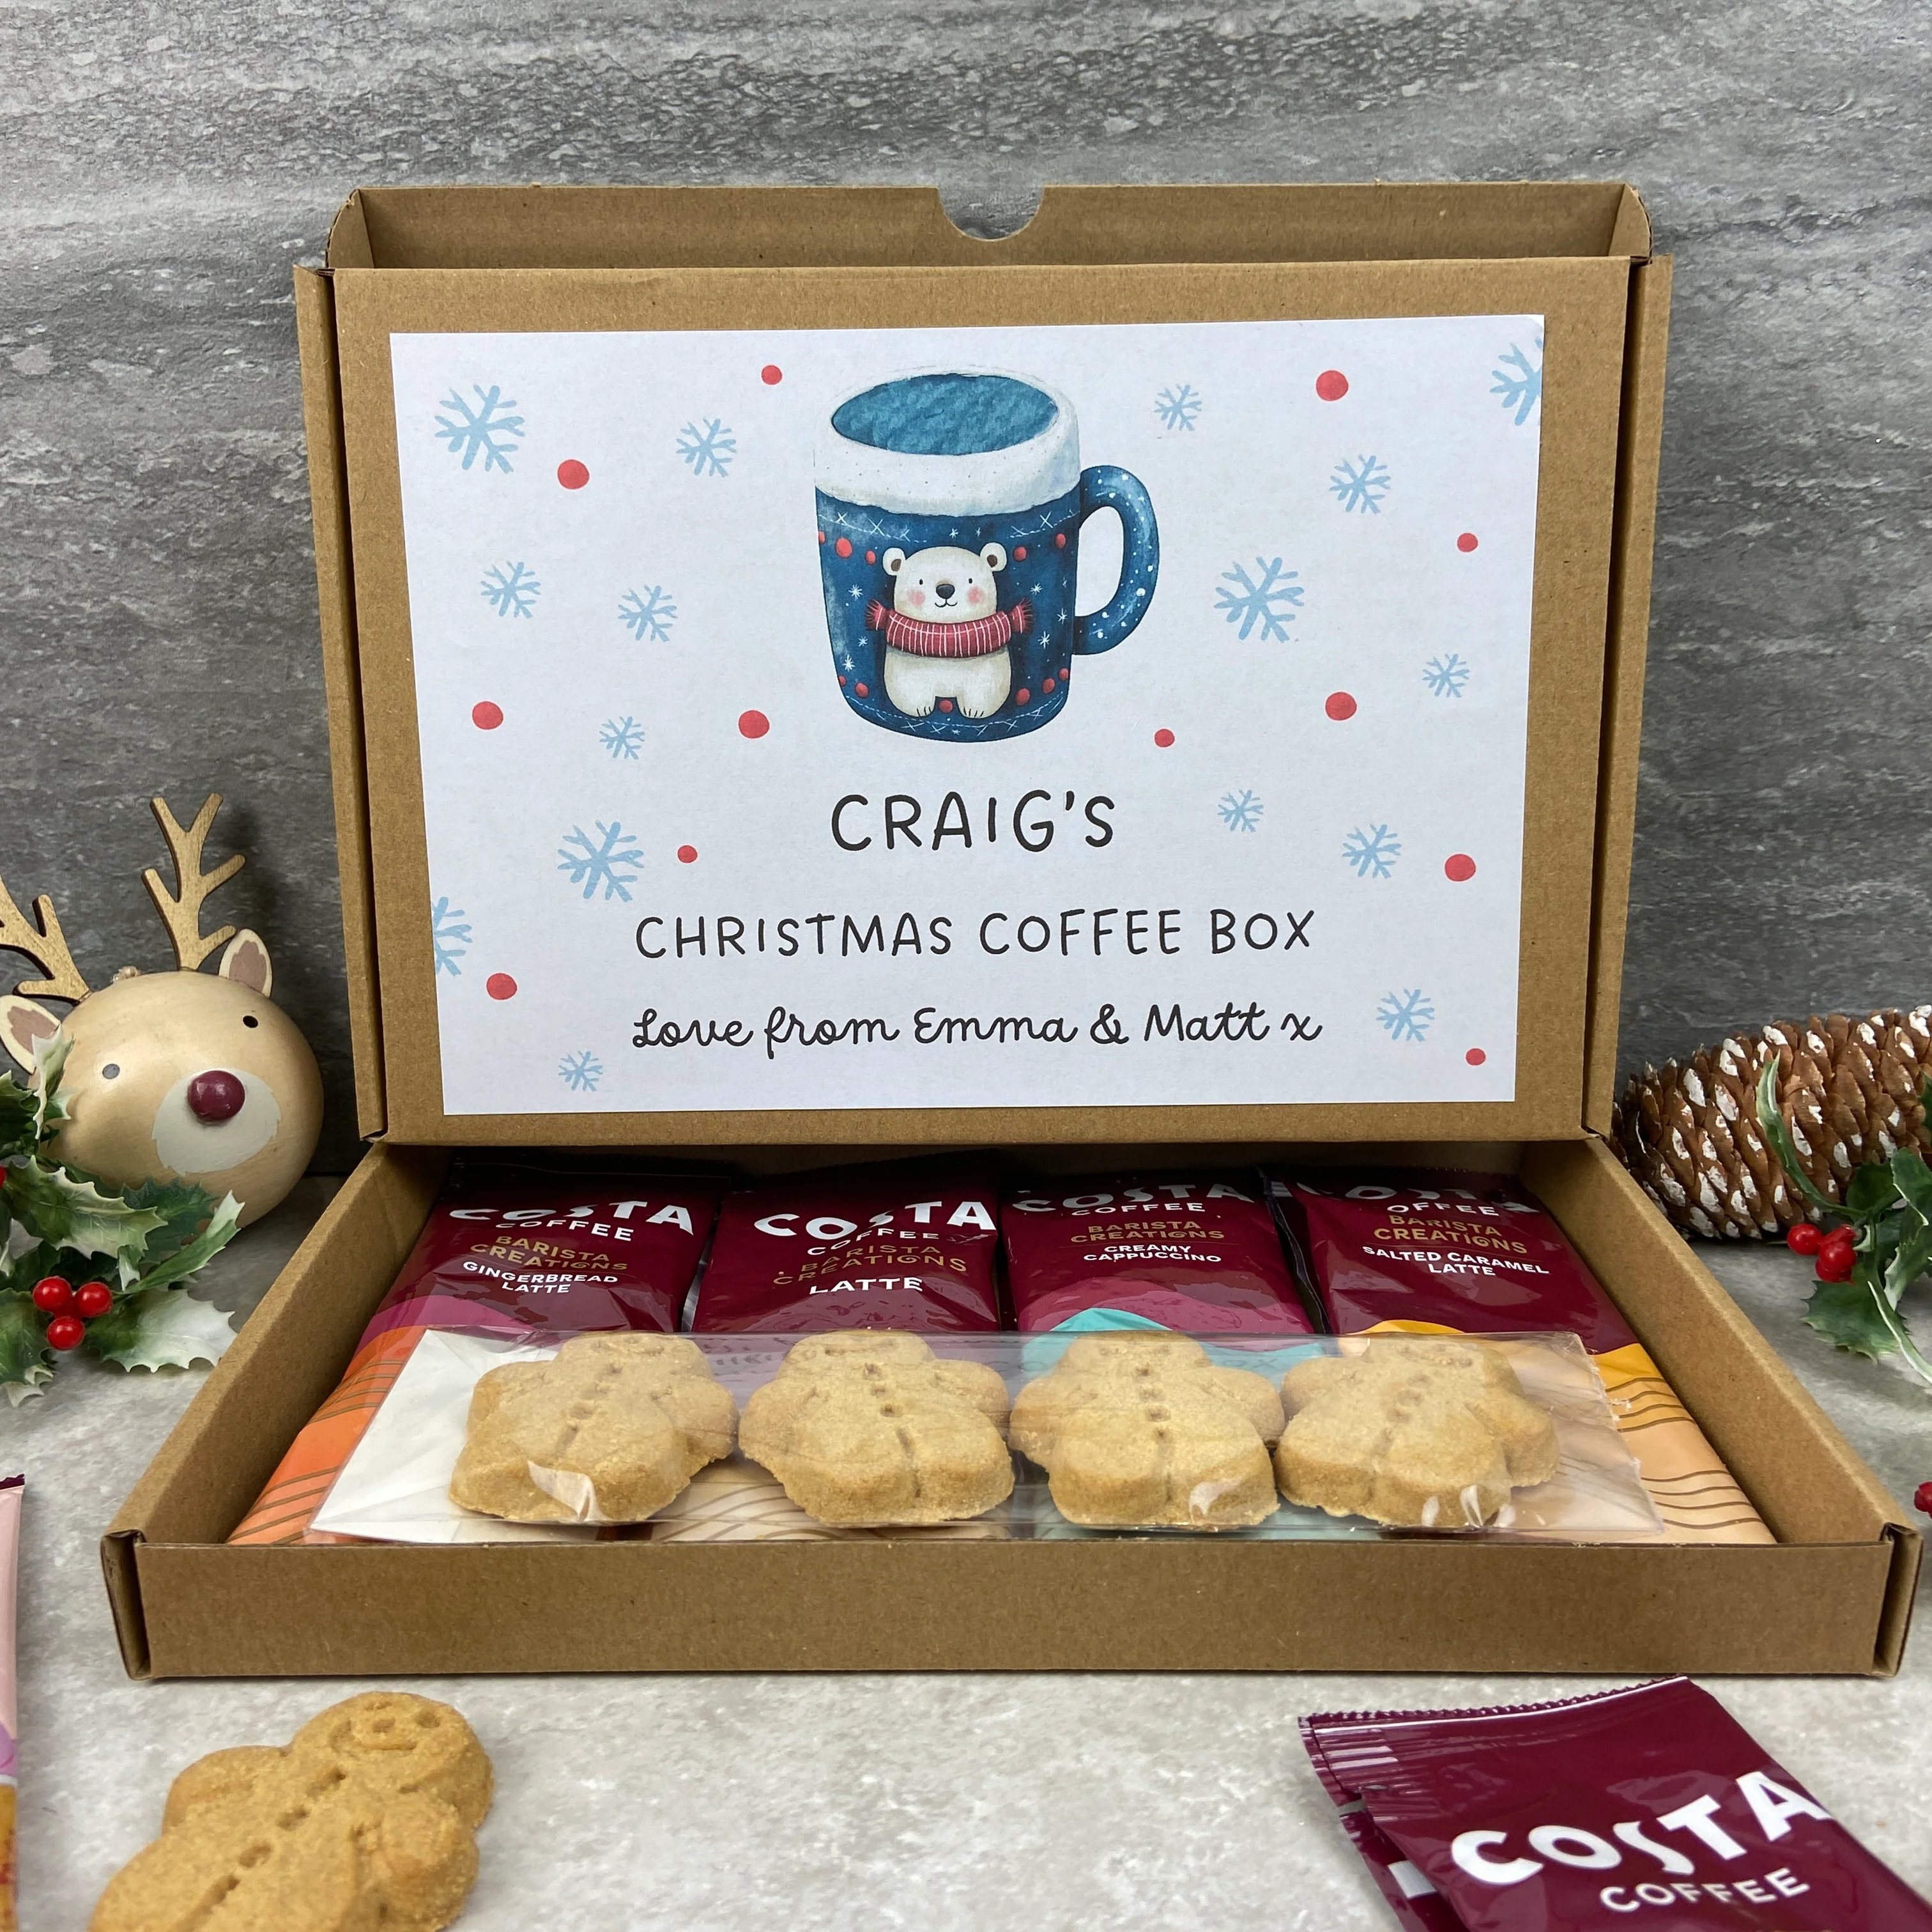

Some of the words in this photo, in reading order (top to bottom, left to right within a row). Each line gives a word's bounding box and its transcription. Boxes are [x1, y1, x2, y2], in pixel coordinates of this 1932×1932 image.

[831, 789, 1116, 852] CRAIG'S
[636, 912, 952, 958] CHRISTMAS
[979, 908, 1181, 956] COFFEE
[1210, 908, 1314, 954] BOX
[632, 1008, 754, 1048] Love
[763, 1006, 900, 1060] from
[914, 1007, 1078, 1044] Emma
[1090, 1003, 1130, 1045] &
[1144, 1002, 1270, 1041] Matt
[1280, 1013, 1323, 1041] x
[1012, 1183, 1255, 1212] COSTA
[1071, 1202, 1206, 1216] COFFEE
[1387, 1202, 1499, 1216] OFFEE
[449, 1200, 694, 1236] COSTA
[495, 1220, 634, 1241] COFFEE
[753, 1200, 997, 1240] COSTA
[1088, 1220, 1201, 1234] BARISTA
[1388, 1215, 1502, 1236] BARISTA
[495, 1236, 610, 1262] BARISTA
[807, 1227, 939, 1255] COFFEE
[1070, 1230, 1225, 1243] CREATIONS
[1104, 1244, 1192, 1253] CREAMY
[1373, 1227, 1528, 1254] CREATIONS
[470, 1243, 629, 1271] CREATIONS
[772, 1255, 967, 1285] CREATIONS
[801, 1245, 941, 1273] BARISTA
[1083, 1252, 1222, 1262] CAPPUCCINO
[1362, 1246, 1442, 1262] SALTED
[1446, 1251, 1550, 1274] CARAMEL
[1427, 1262, 1496, 1276] LATTE
[463, 1261, 618, 1284] GINGERBREAD
[809, 1276, 923, 1295] LATTE
[501, 1281, 572, 1294] LATTE
[1450, 1770, 1835, 1885] COSTA
[1599, 1867, 1811, 1913] COFFEE
